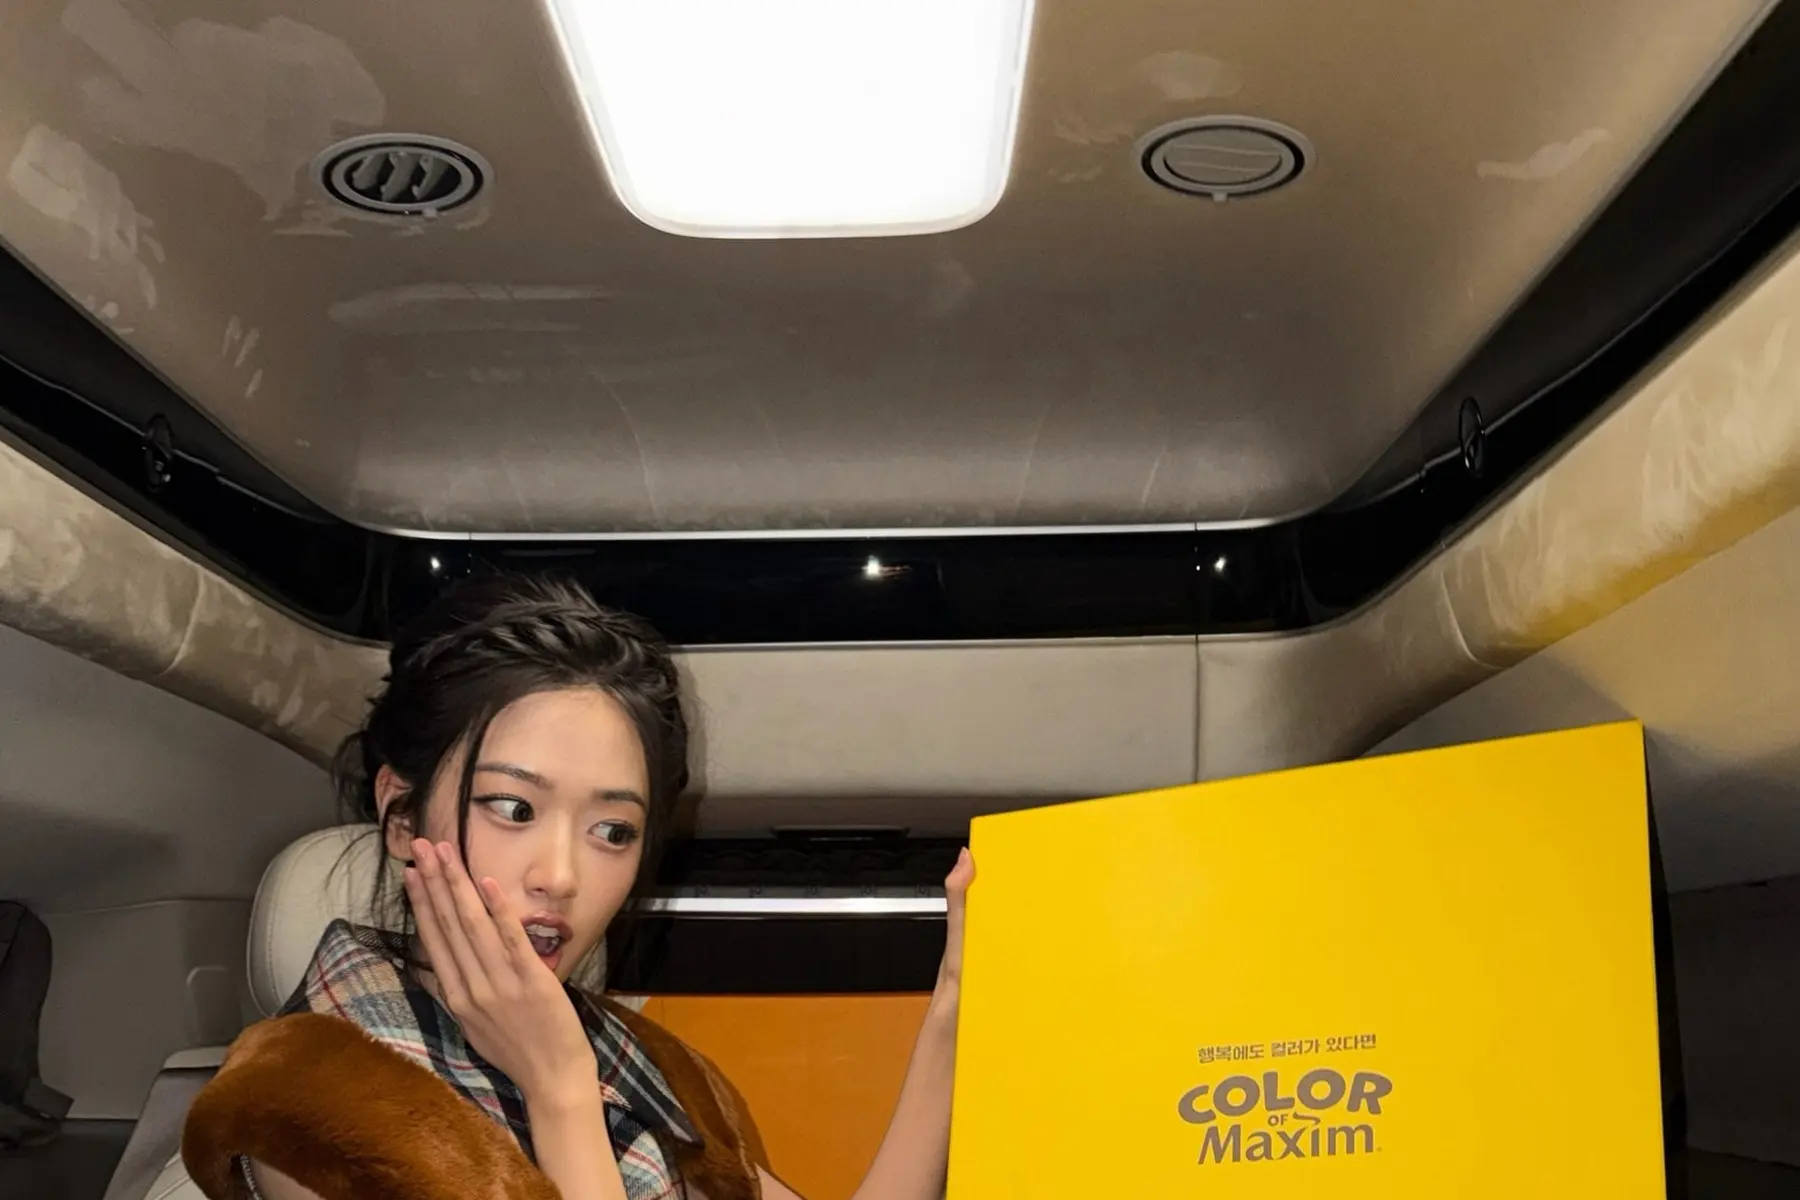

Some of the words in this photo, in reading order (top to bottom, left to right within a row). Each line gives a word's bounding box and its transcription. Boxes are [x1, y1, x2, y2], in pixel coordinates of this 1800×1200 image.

[1198, 1043, 1264, 1064] 행복에도
[1270, 1038, 1320, 1058] 컬러가
[1326, 1033, 1376, 1053] 있다면
[1178, 1068, 1393, 1125] COLOR
[1197, 1113, 1374, 1165] Maxim
[1267, 1113, 1288, 1127] OF
